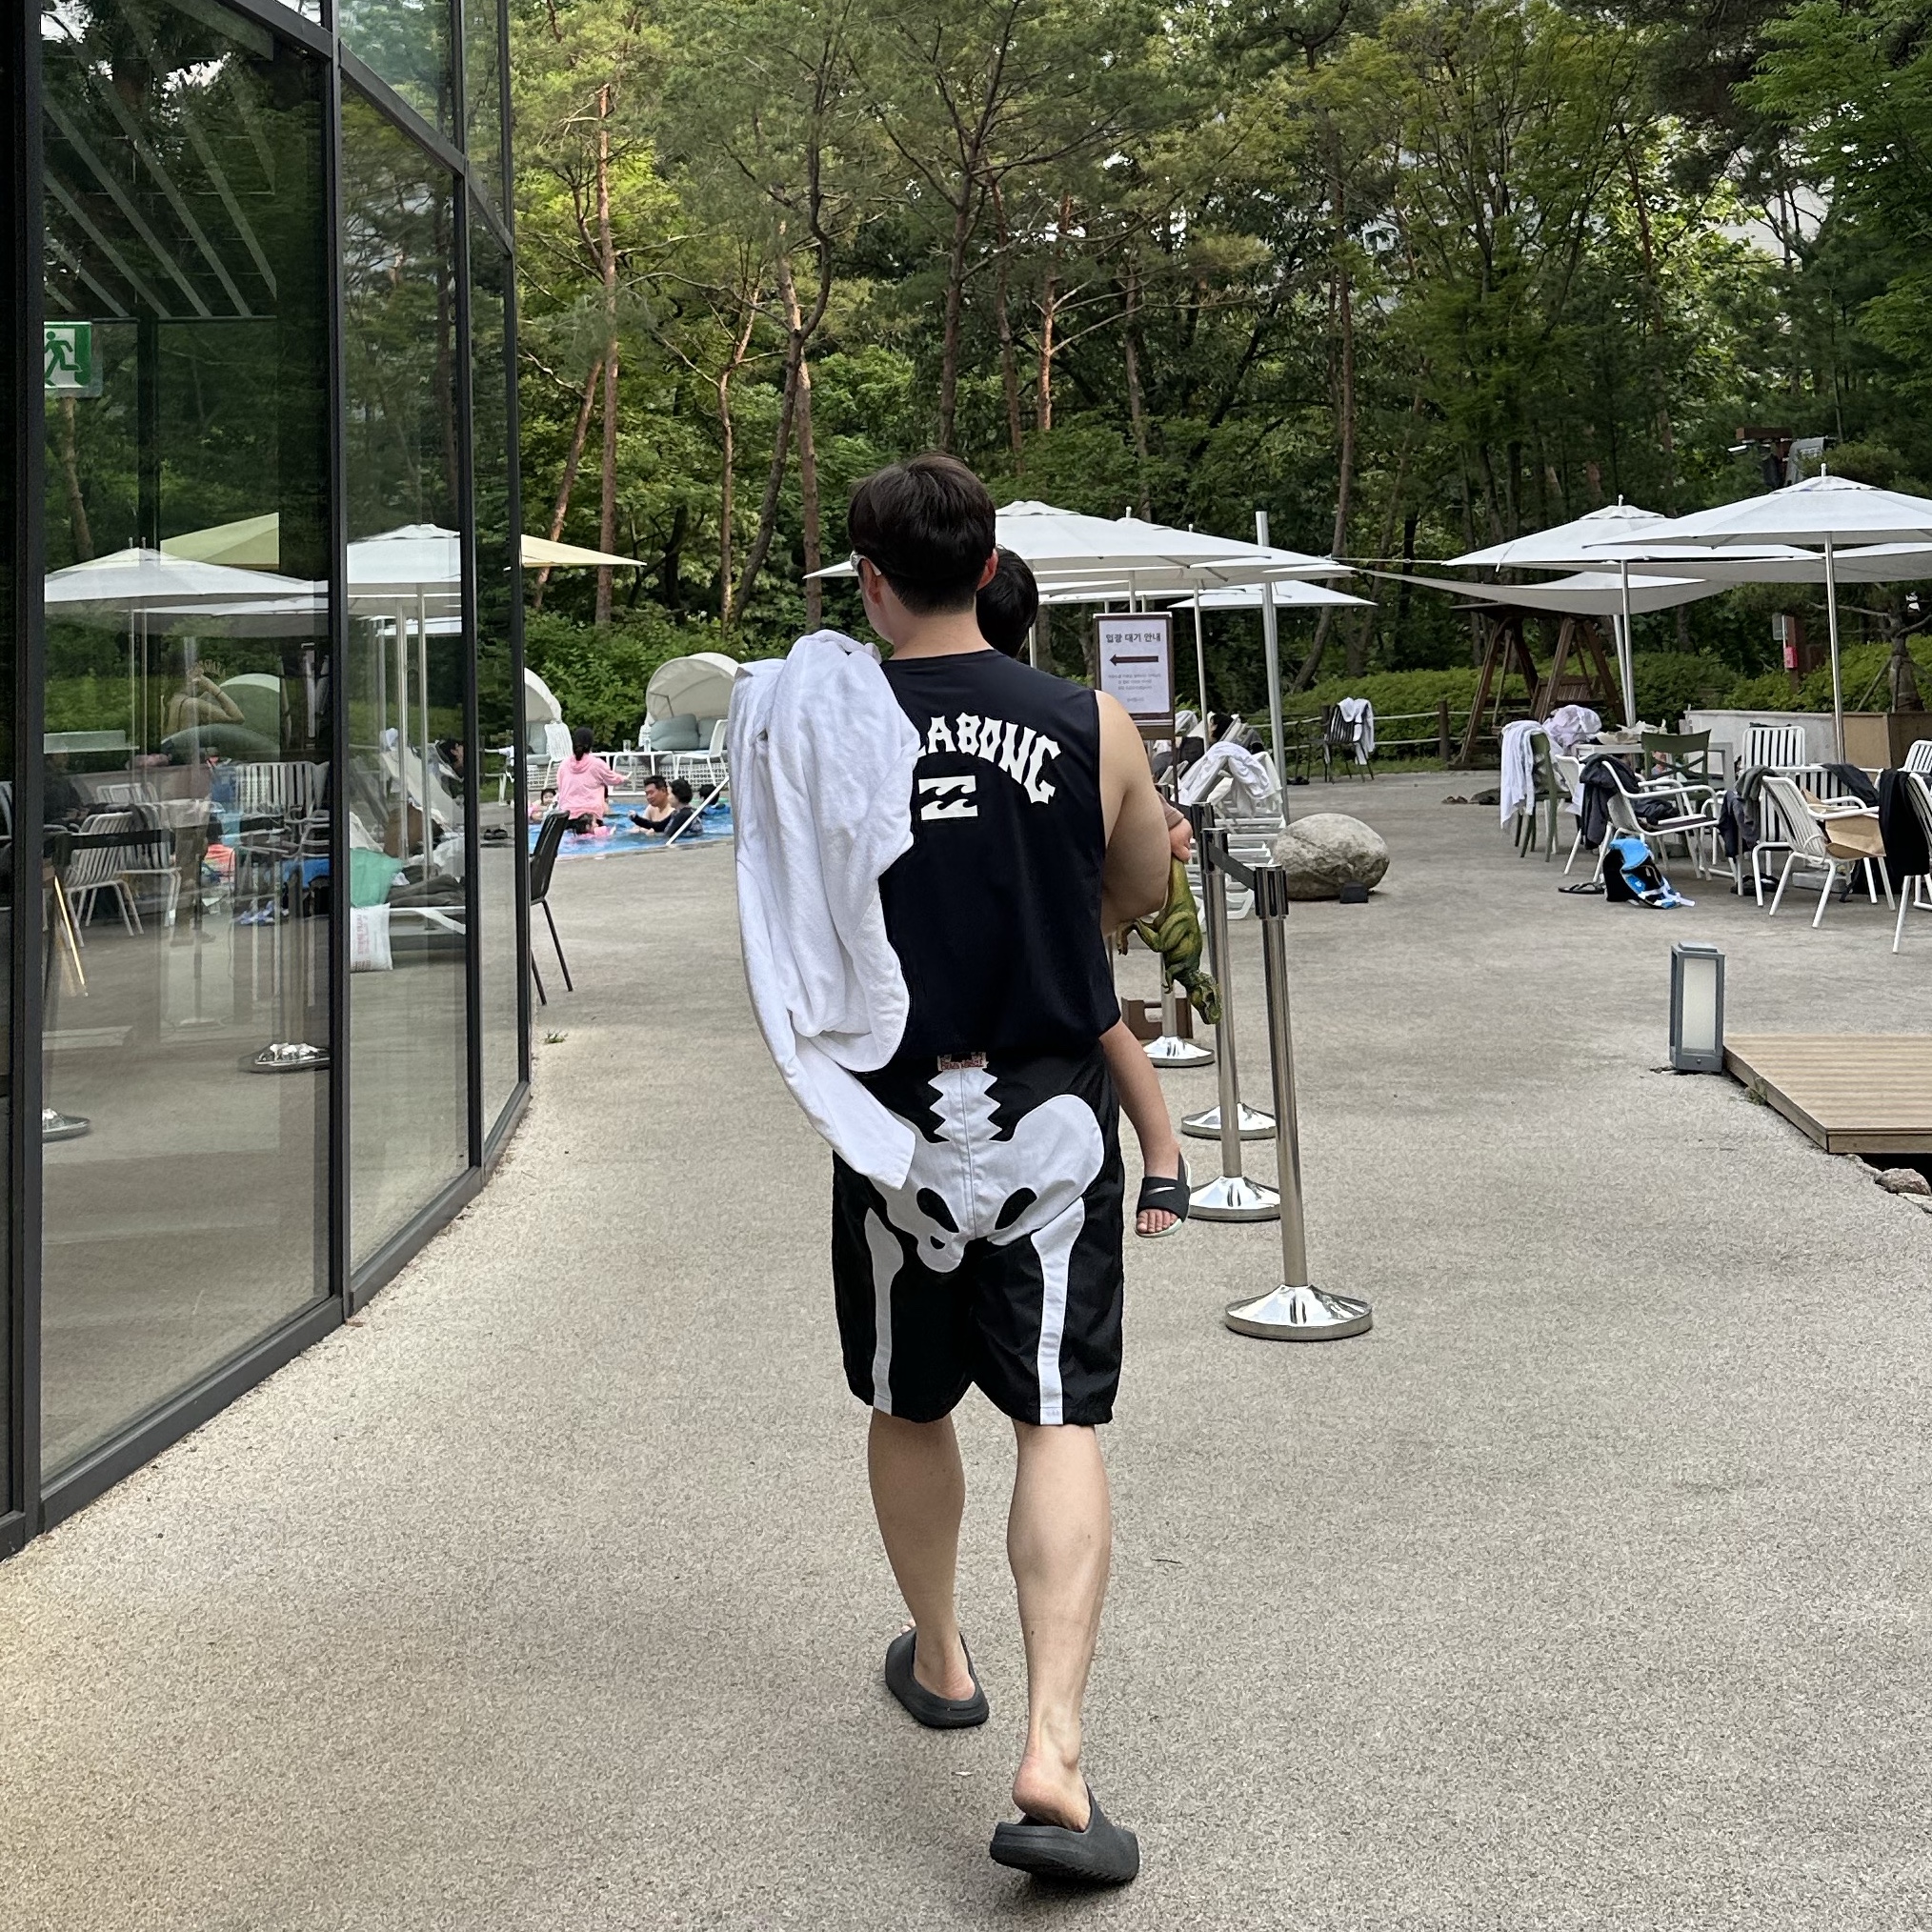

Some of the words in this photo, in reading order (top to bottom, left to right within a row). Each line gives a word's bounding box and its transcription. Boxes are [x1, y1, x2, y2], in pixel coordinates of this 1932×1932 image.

[1124, 633, 1141, 643] 대기
[1143, 633, 1161, 643] 안내
[918, 713, 1061, 804] ABONG
